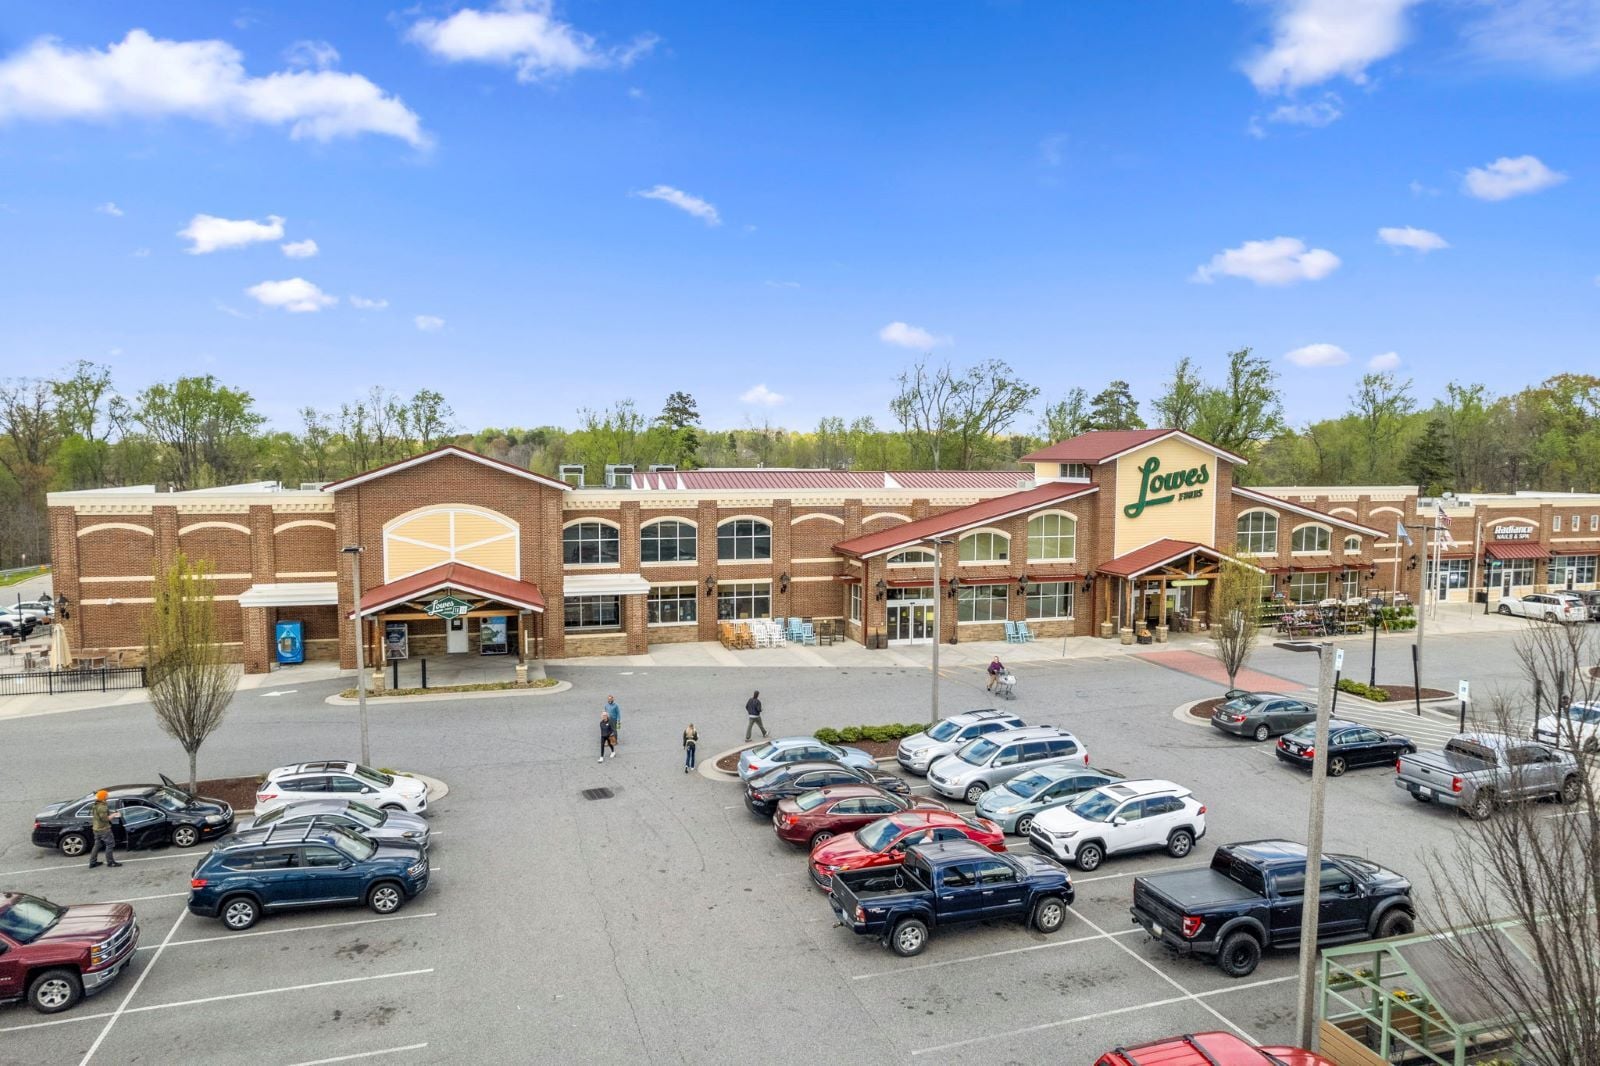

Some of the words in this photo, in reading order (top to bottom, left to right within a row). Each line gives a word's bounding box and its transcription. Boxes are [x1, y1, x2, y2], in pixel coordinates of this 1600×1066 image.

[1124, 457, 1209, 518] Lowes
[1494, 525, 1533, 534] Radiance
[428, 600, 454, 615] Lowes
